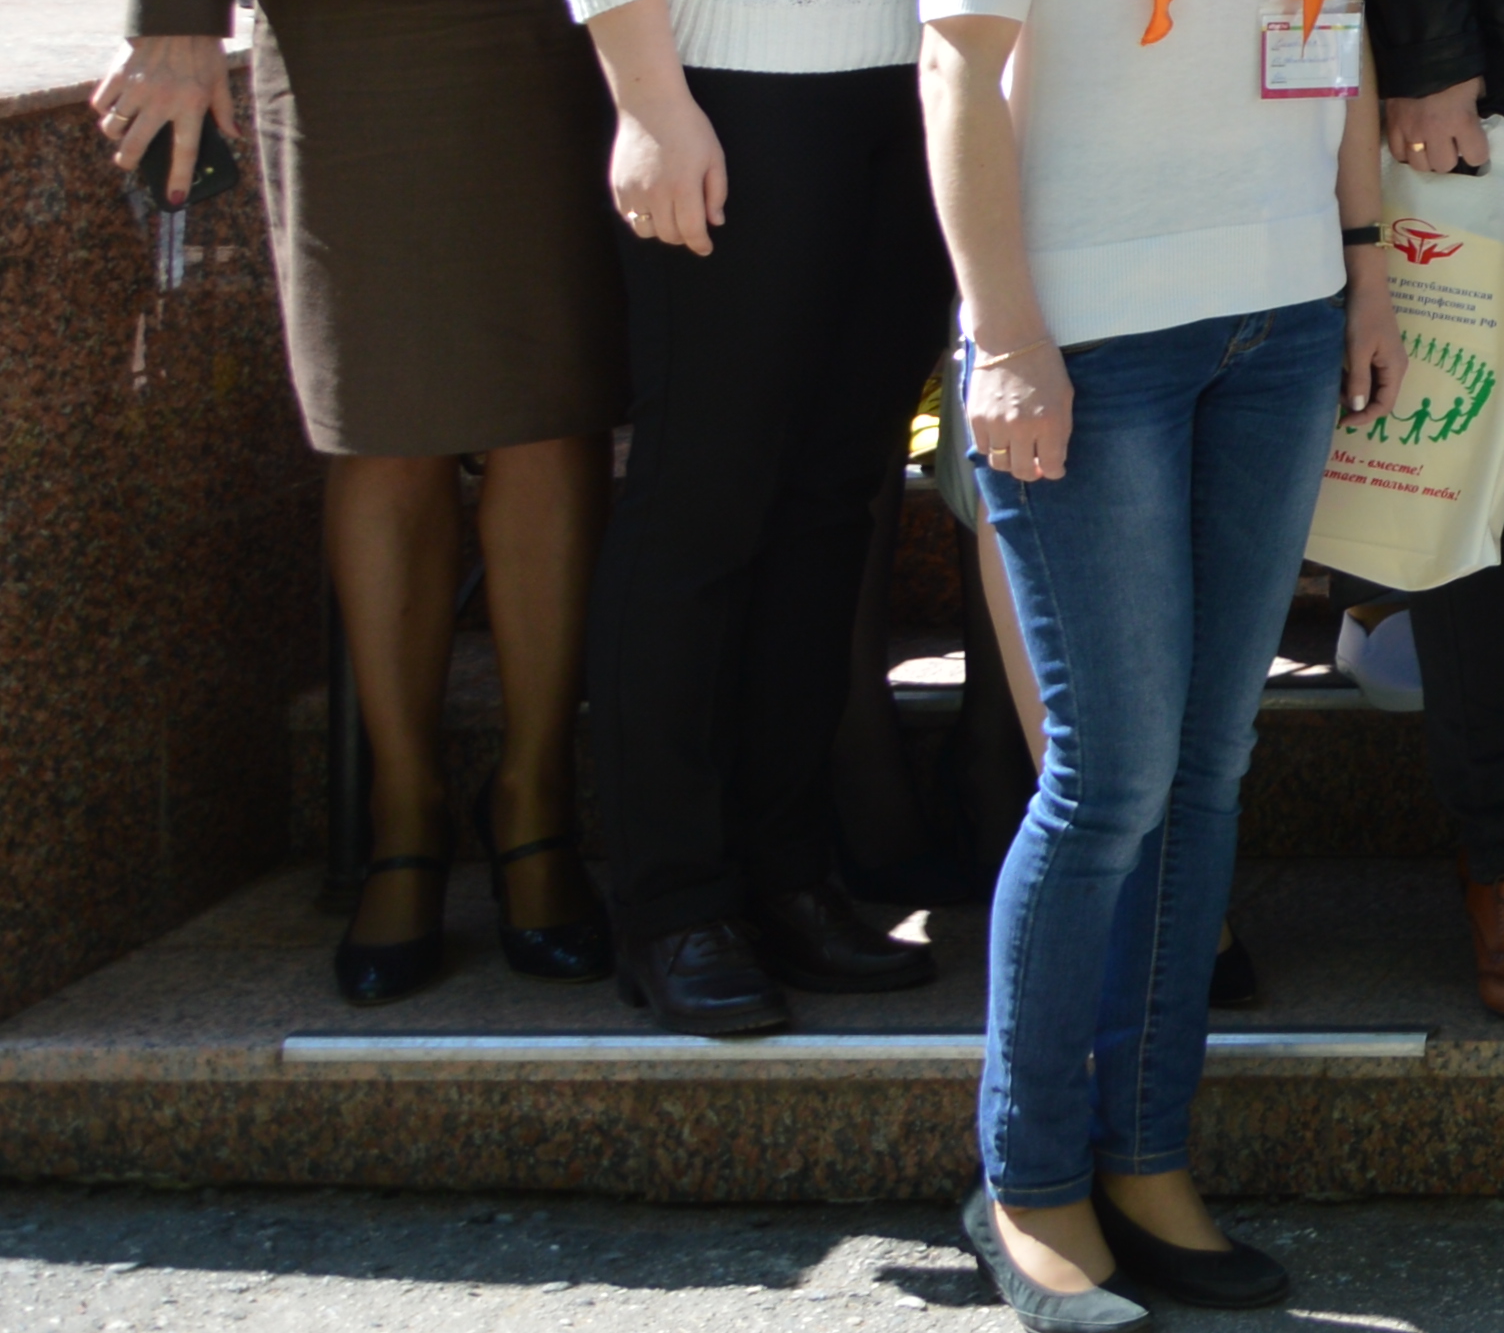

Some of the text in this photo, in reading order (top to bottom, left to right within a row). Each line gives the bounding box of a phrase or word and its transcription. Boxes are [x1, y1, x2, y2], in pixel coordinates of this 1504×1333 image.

[1399, 277, 1494, 302] республиканская
[1392, 304, 1498, 329] равоохранения РФ
[1331, 449, 1356, 464] Мы
[1367, 458, 1424, 477] вместе!
[1322, 468, 1462, 501] атает только тебя!
